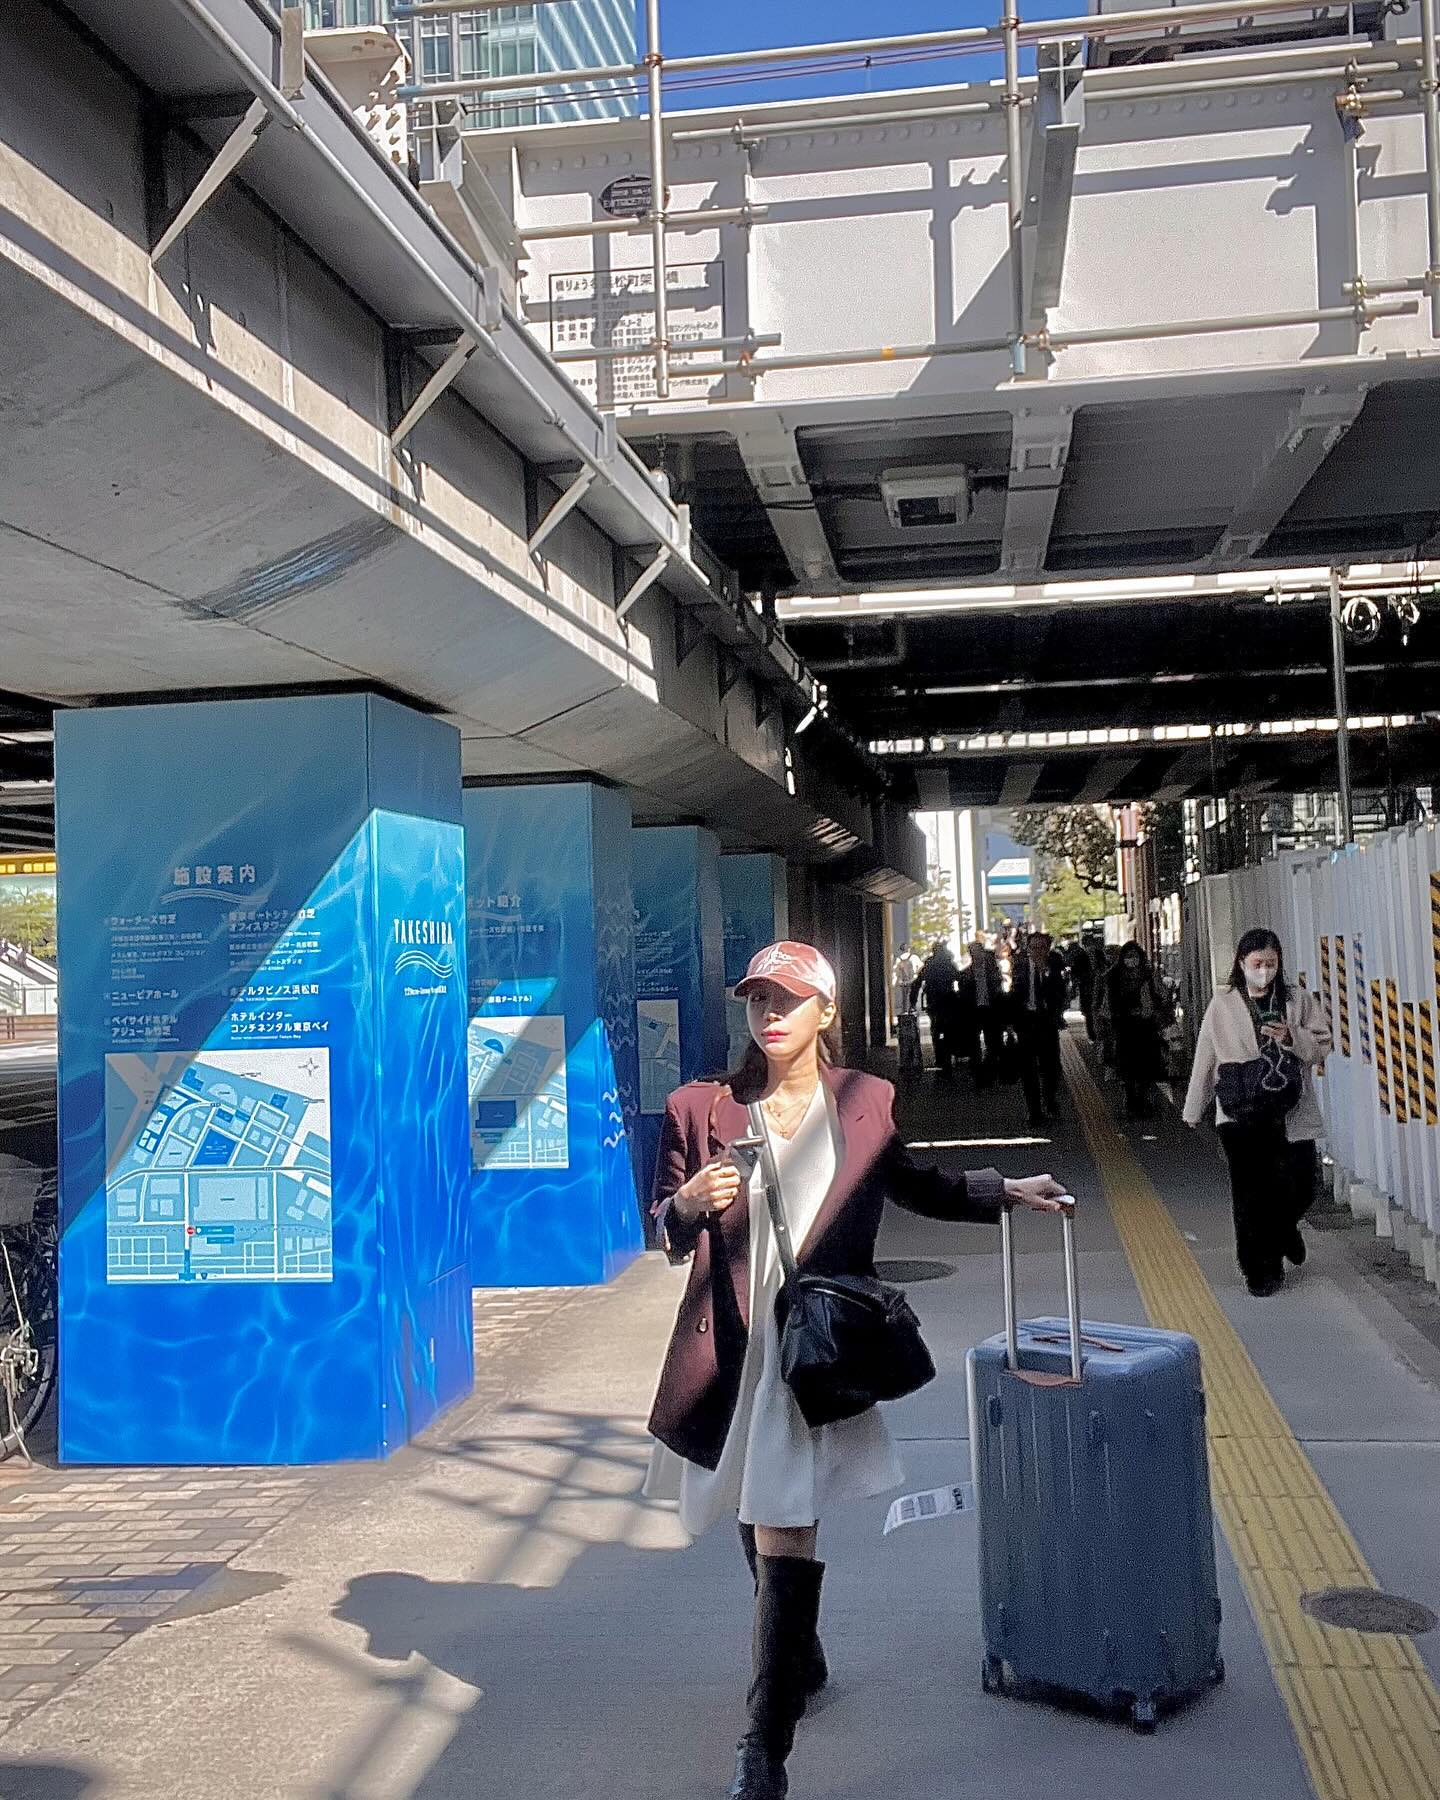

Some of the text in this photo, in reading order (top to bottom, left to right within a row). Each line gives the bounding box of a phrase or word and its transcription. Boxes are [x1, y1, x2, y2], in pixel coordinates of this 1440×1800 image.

[173, 863, 256, 887] 施設案内
[394, 918, 453, 945] TAKESHIBA
[231, 1011, 293, 1022] ホテルインター
[231, 1021, 330, 1034] コンチネンタル東京ベイ
